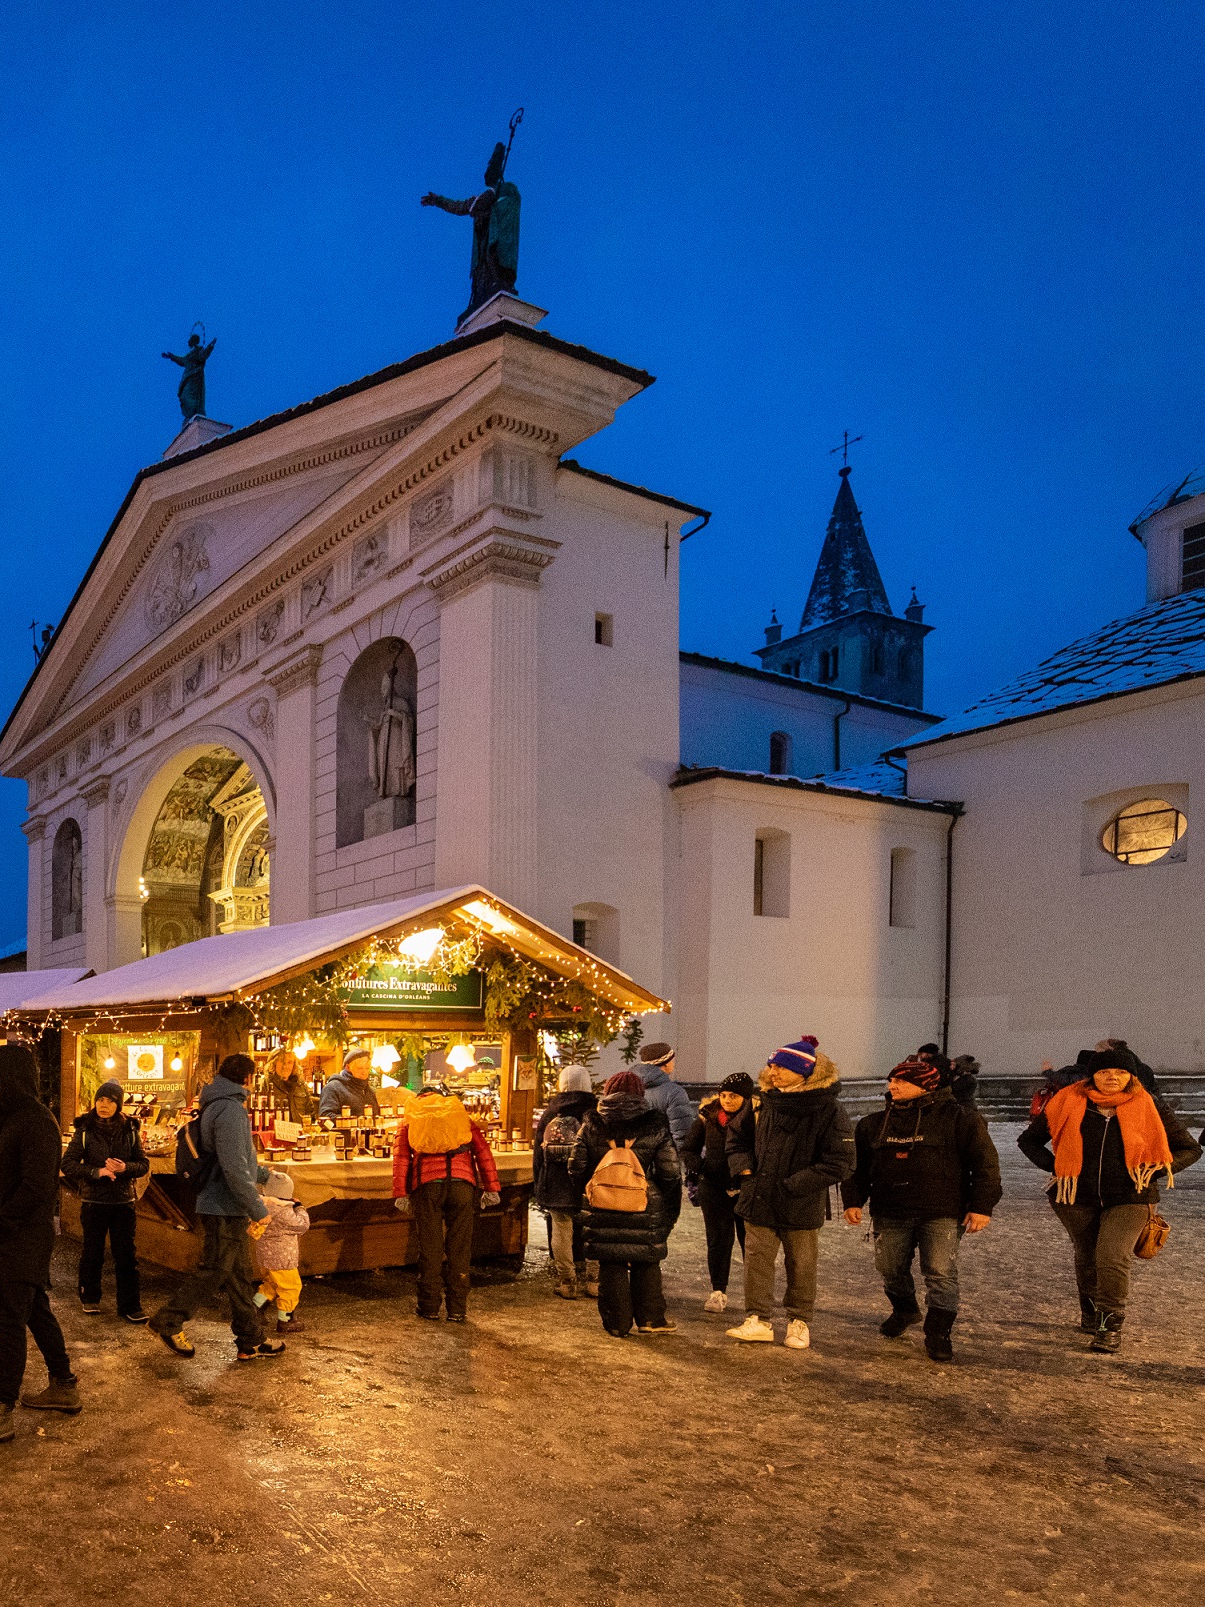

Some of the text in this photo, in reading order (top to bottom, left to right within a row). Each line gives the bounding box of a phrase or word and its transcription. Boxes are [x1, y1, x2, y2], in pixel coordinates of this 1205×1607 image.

[341, 976, 389, 989] onfitures
[121, 1082, 186, 1093] etture extravagant
